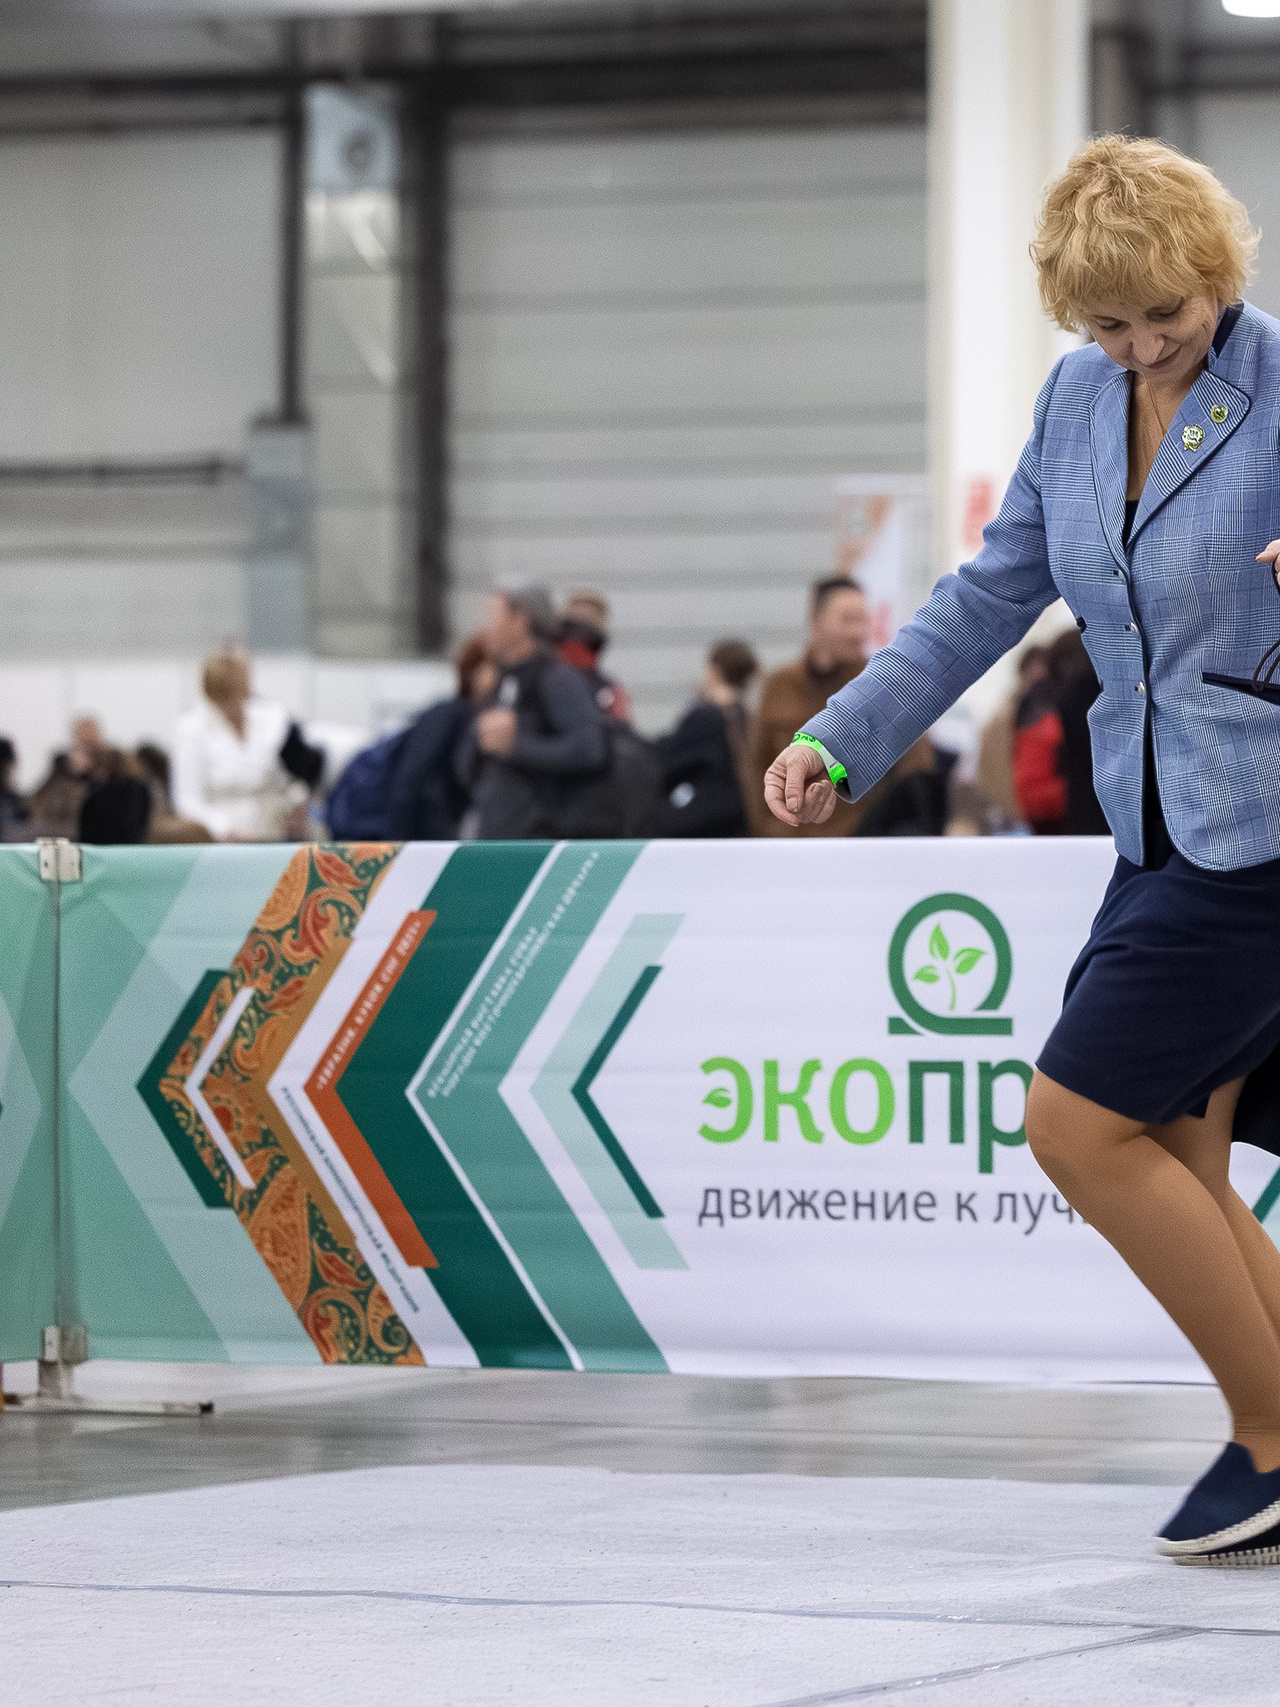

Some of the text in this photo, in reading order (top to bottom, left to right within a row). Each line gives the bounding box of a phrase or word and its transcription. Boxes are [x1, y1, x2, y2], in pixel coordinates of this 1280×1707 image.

[697, 1187, 1091, 1235] движение к луч
